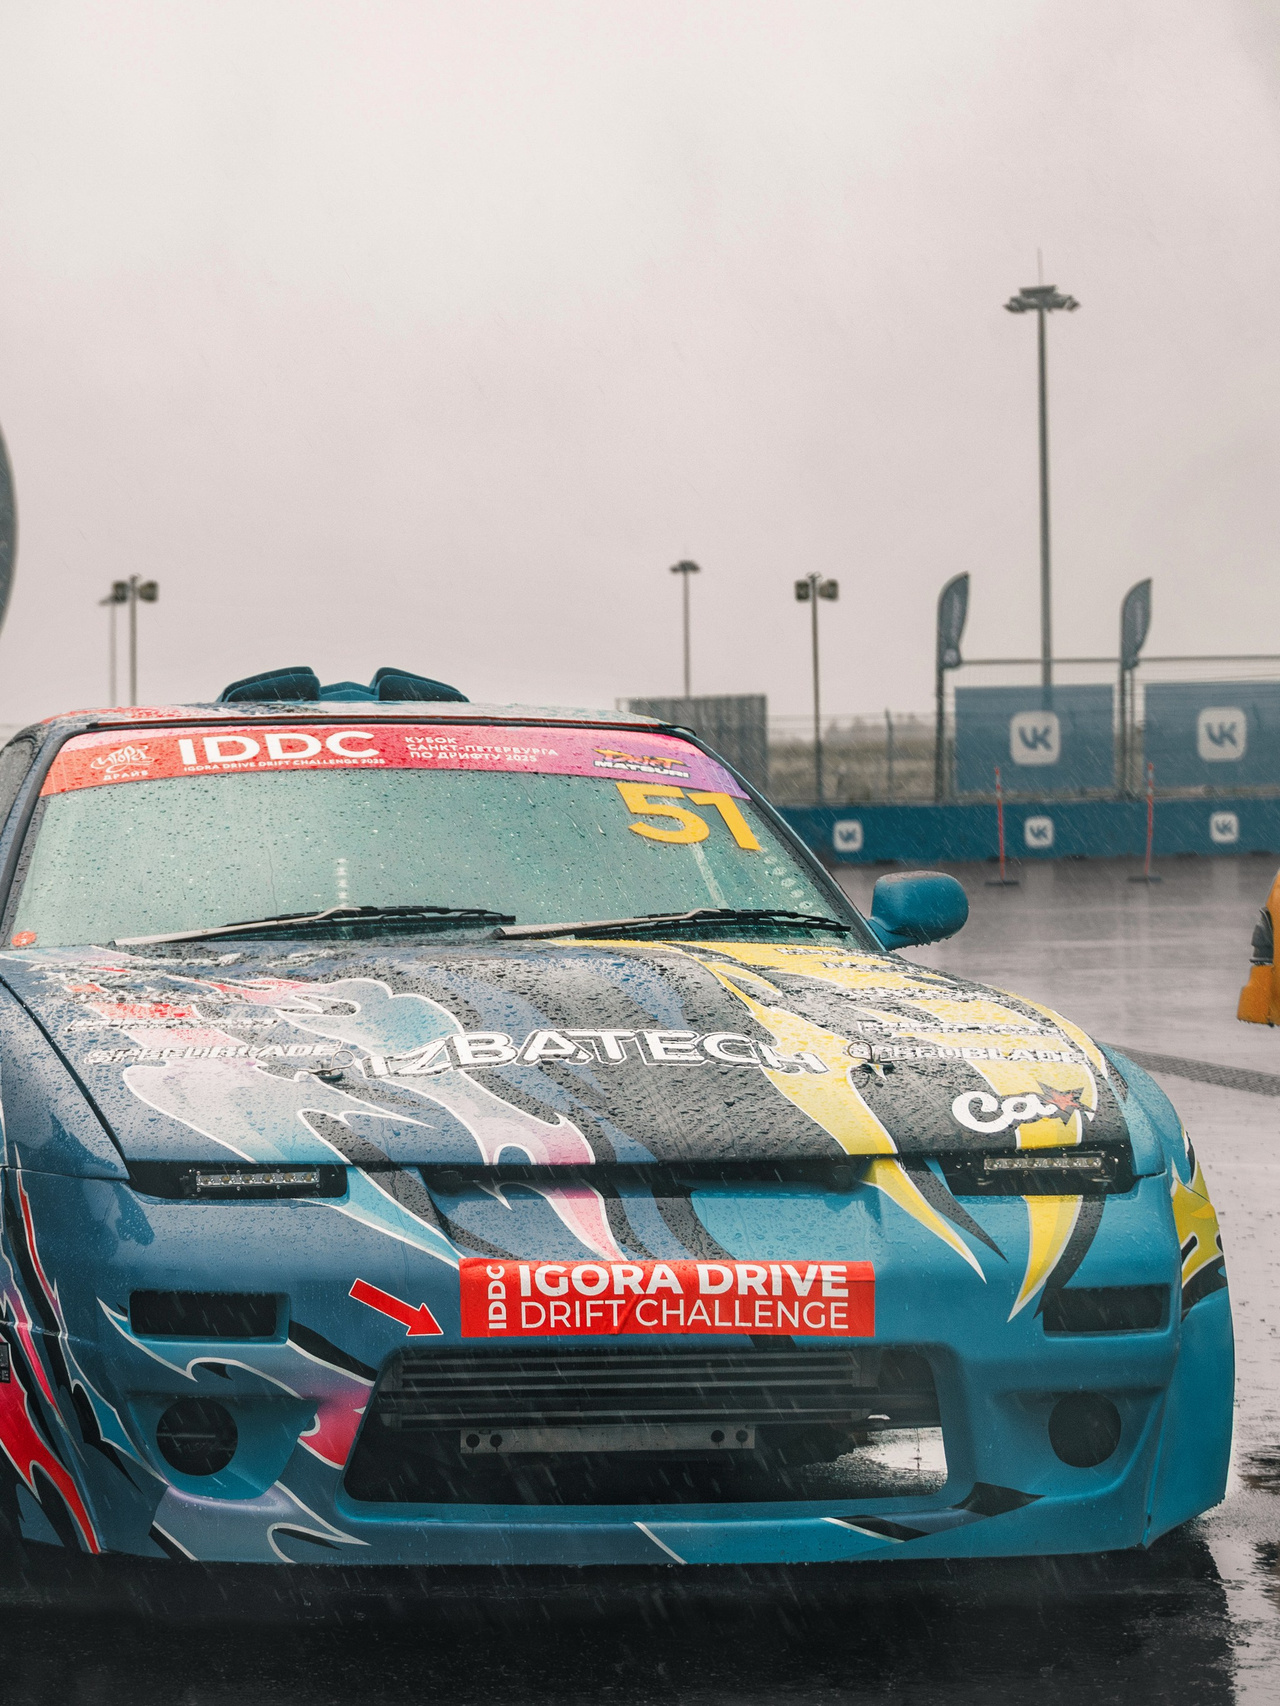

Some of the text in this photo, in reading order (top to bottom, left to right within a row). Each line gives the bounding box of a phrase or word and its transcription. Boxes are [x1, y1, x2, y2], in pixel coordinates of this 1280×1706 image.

[178, 730, 380, 765] IDDC
[405, 736, 457, 744] КУБОК
[1019, 725, 1053, 751] VK
[1204, 721, 1238, 748] VK
[407, 743, 559, 757] САНКТ-ПЕТЕРБУРГА
[410, 751, 538, 762] ПО ДРИФТУ 2025
[103, 770, 149, 781] ДРАЙВ
[184, 763, 220, 772] IGORA
[223, 761, 256, 770] DRIVE
[258, 760, 291, 768] DRIFT
[293, 758, 359, 766] CHALLENGE
[615, 782, 761, 851] 51
[362, 1027, 831, 1081] IZBATECH
[520, 1264, 849, 1297] IGORA DRIVE
[487, 1264, 507, 1329] IDDC
[521, 1299, 849, 1329] DRIFT CHALLENGE
